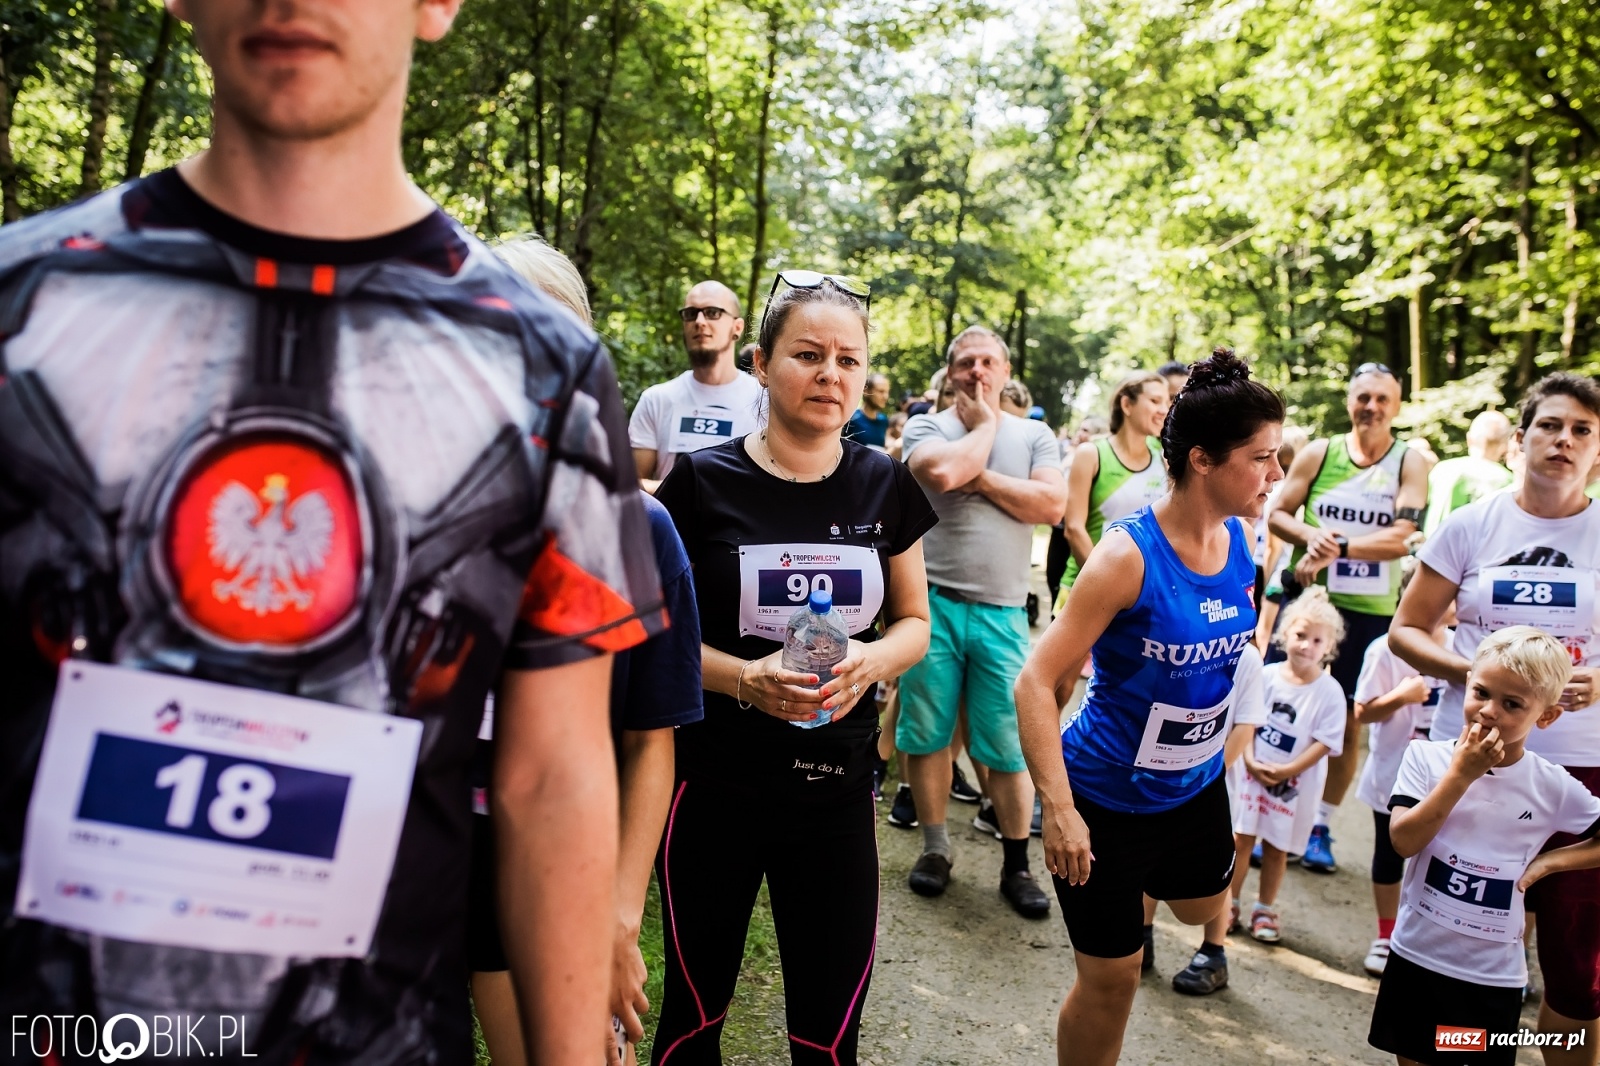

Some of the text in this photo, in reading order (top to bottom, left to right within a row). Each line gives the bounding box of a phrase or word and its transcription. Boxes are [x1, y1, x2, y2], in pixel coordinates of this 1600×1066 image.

[693, 419, 719, 434] 52
[1348, 563, 1369, 577] 70
[787, 573, 833, 602] 90
[1513, 582, 1553, 604] 28
[1183, 719, 1216, 742] 49
[1260, 725, 1283, 746] 26
[792, 758, 845, 775] Just do it.
[155, 754, 276, 839] 18
[1447, 871, 1487, 902] 51
